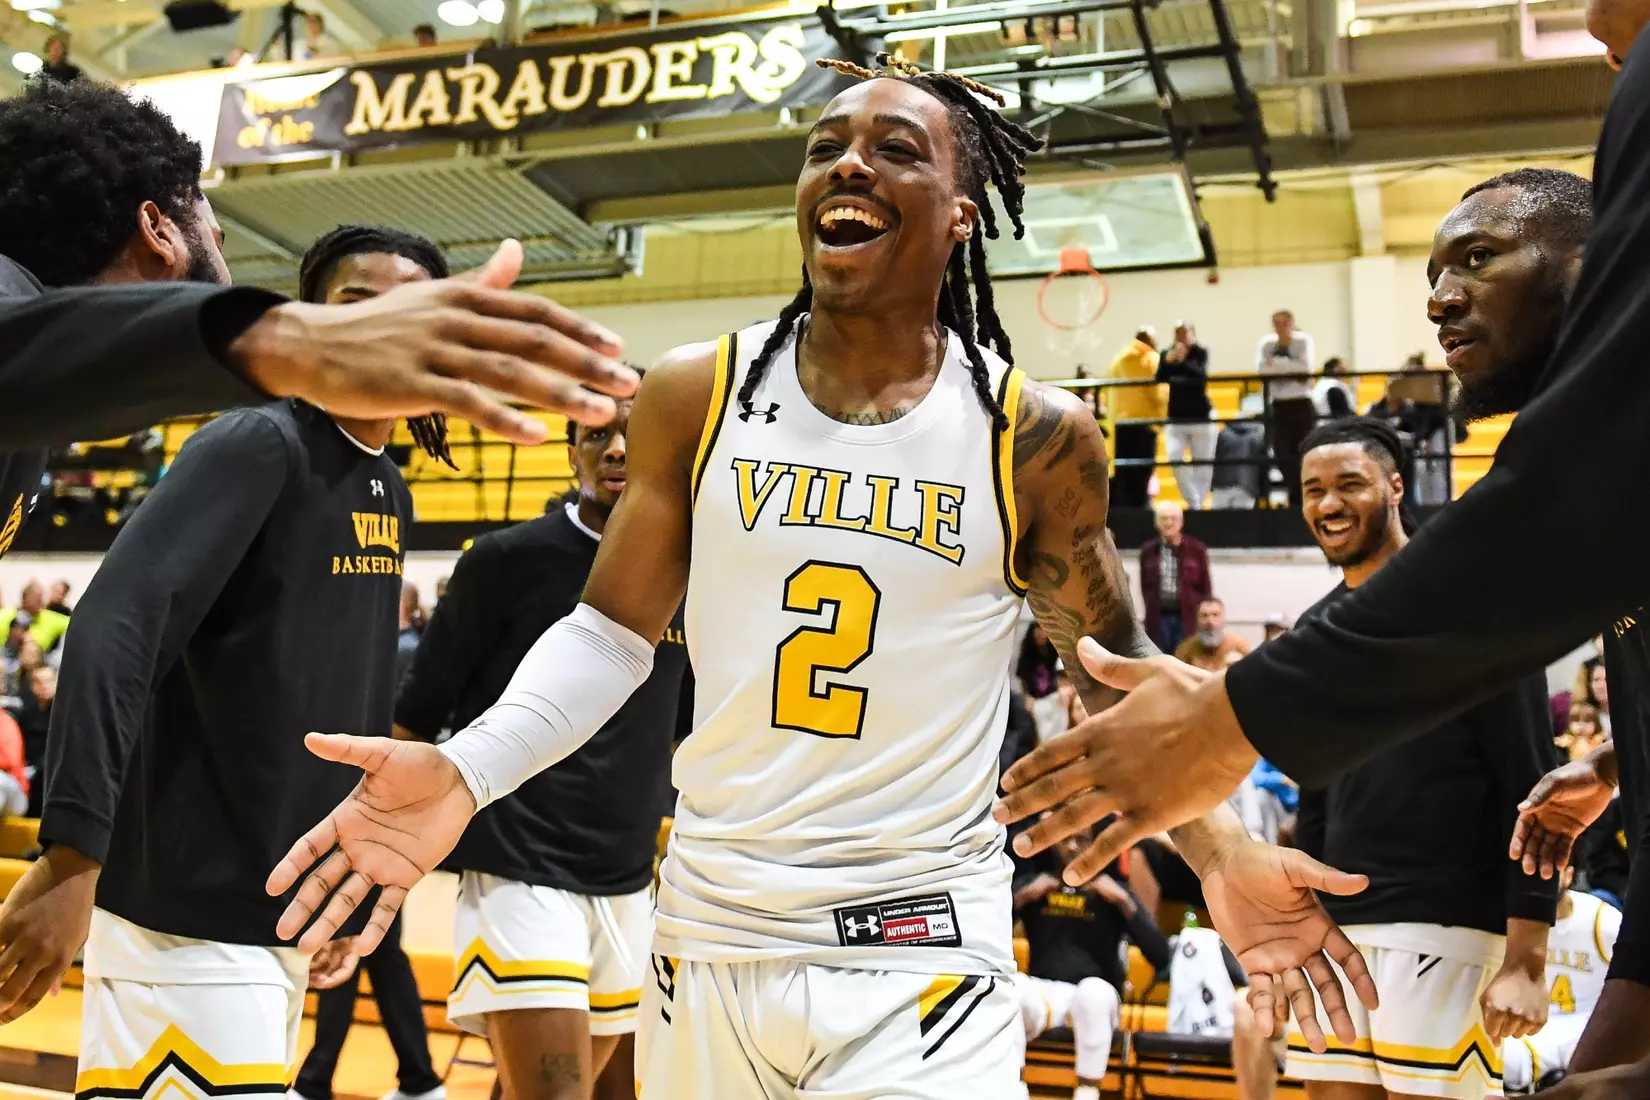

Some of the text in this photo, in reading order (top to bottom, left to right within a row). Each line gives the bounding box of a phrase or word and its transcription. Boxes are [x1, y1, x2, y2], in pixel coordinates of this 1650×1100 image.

[344, 23, 807, 136] MARAUDERS
[270, 115, 315, 145] the
[731, 458, 965, 566] VILLE
[332, 555, 404, 575] BASKETBA
[771, 559, 882, 740] 2
[883, 902, 948, 917] UNDER ARMOUR
[886, 922, 949, 938] AUTHENTIC MD
[1547, 948, 1593, 973] LLE
